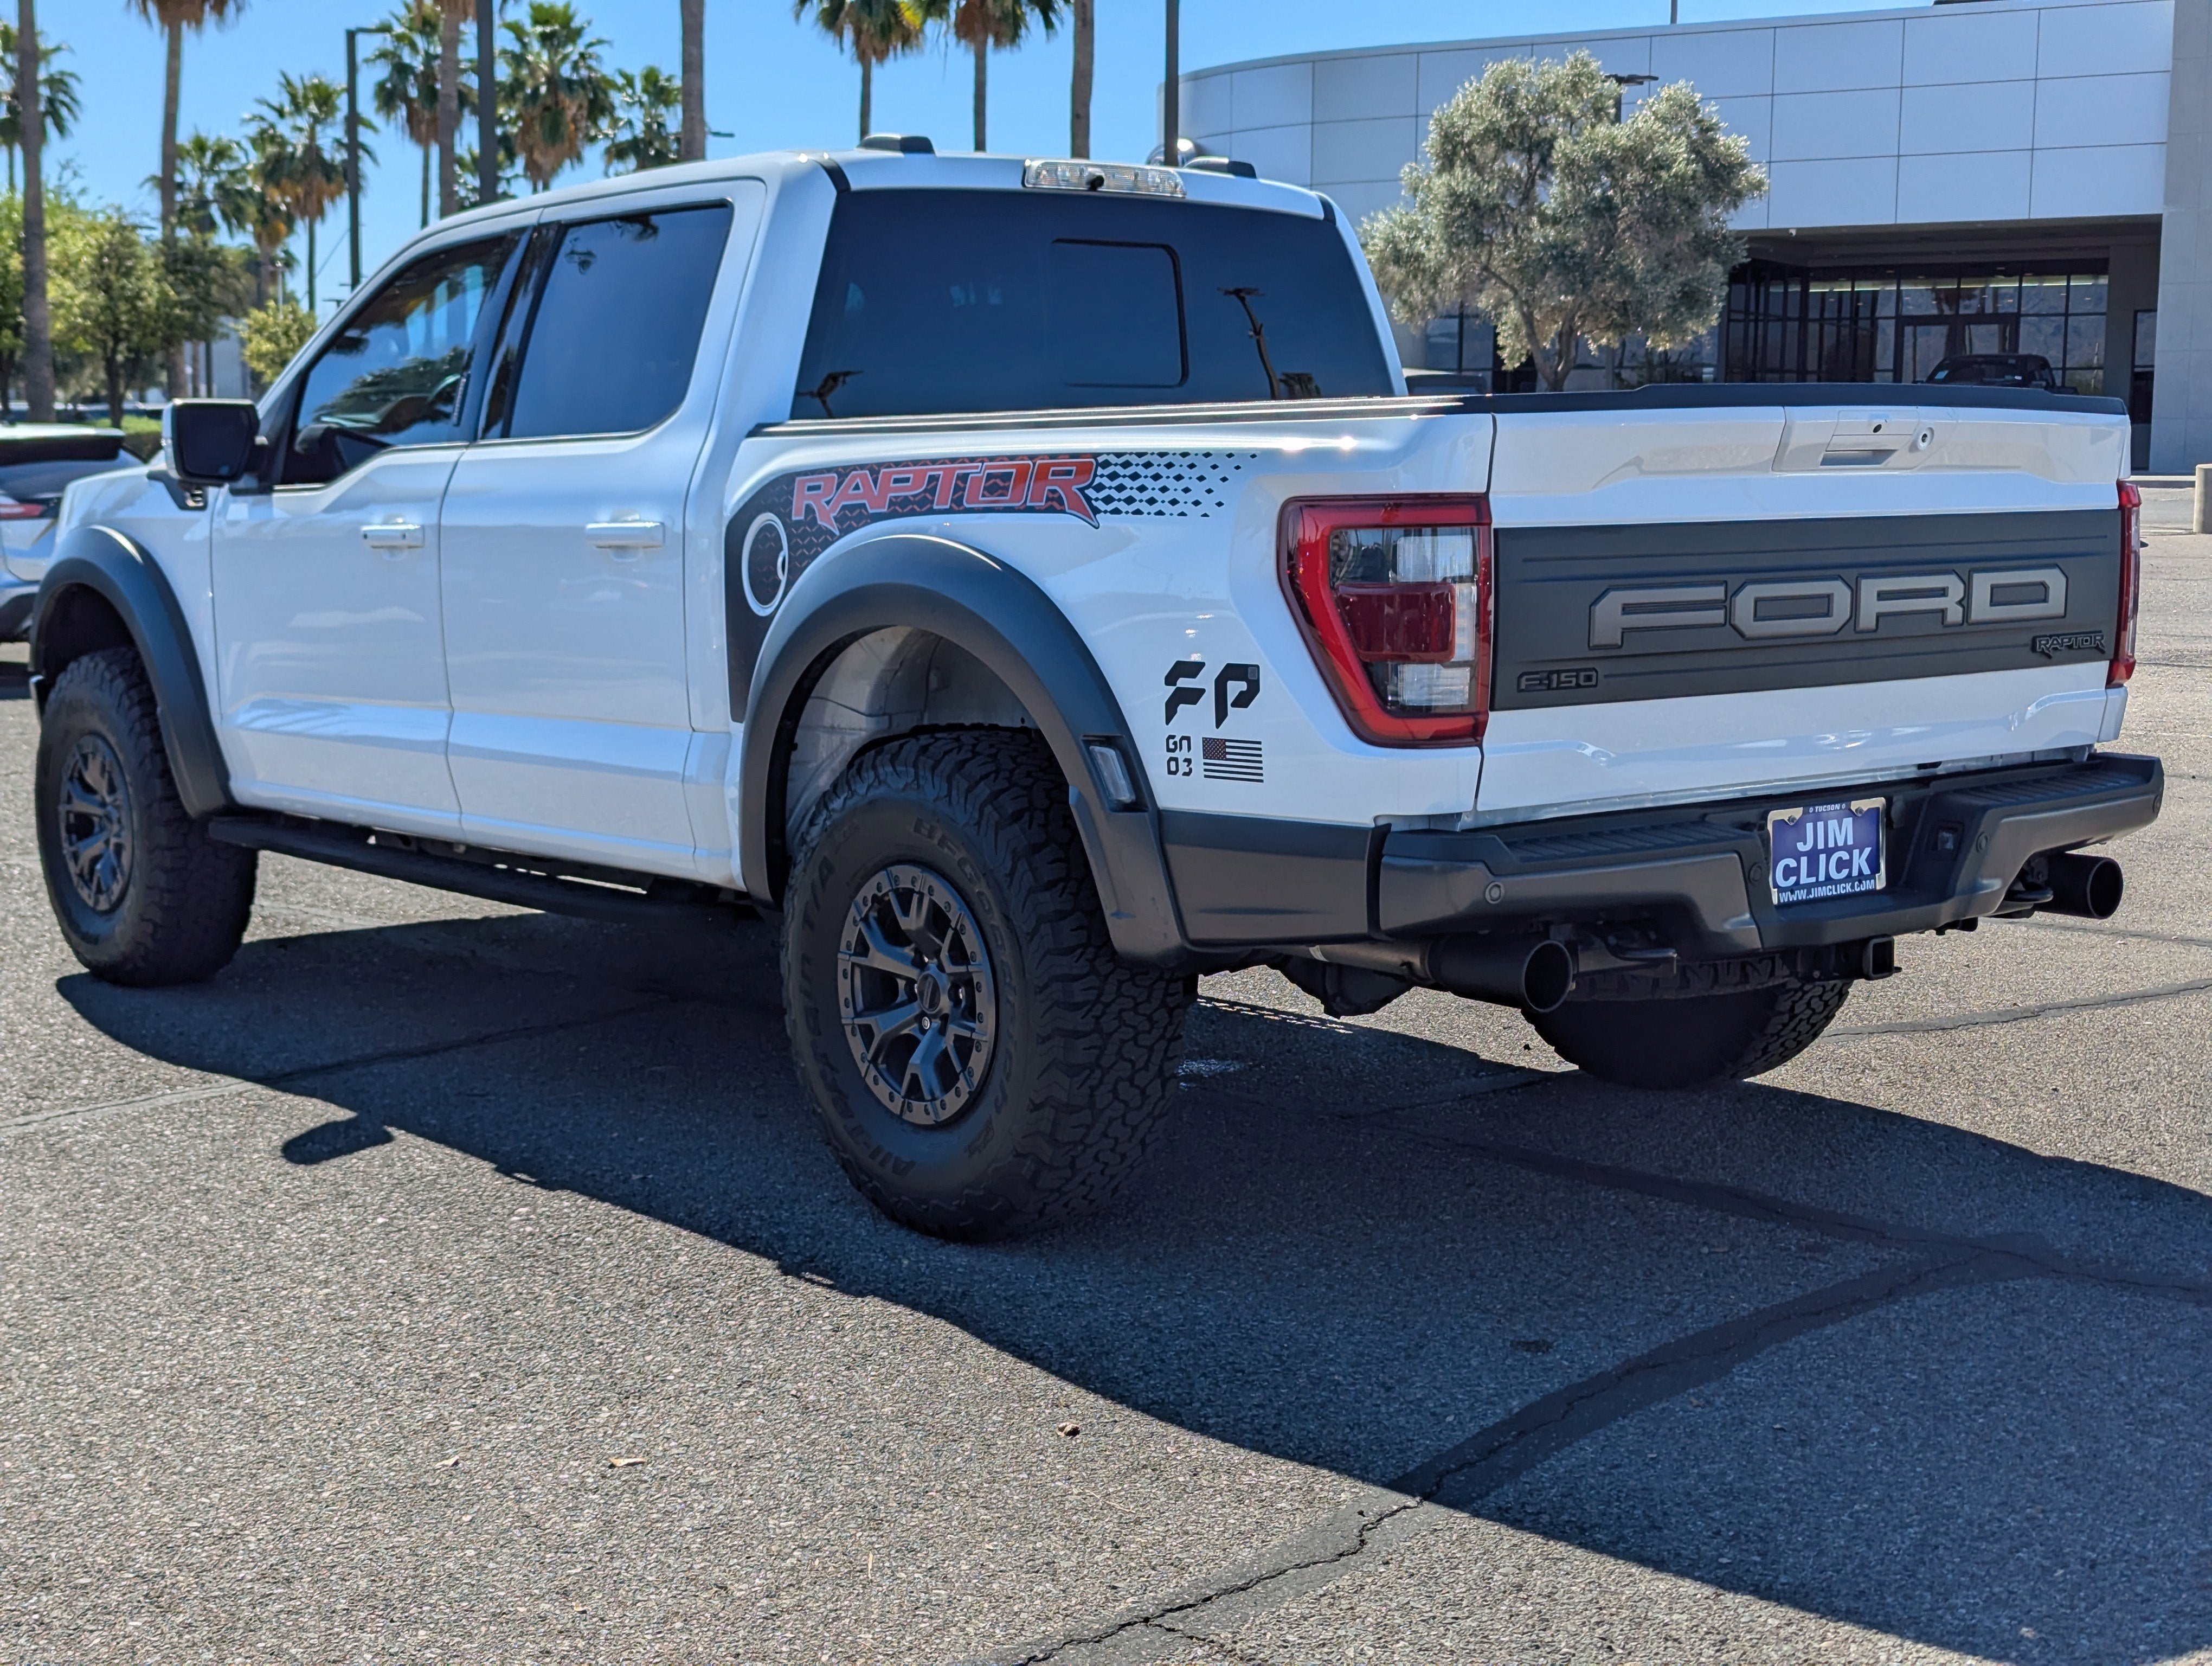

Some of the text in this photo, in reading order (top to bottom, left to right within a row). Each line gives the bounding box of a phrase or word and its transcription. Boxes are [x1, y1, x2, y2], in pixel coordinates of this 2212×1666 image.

[792, 458, 1099, 536] RAPTOR
[1588, 563, 2068, 650] FORD
[2035, 632, 2106, 658] RAPTOR
[1165, 660, 1261, 729] FP
[1518, 668, 1598, 691] F-150
[1815, 804, 1841, 813] TUCSON
[1797, 817, 1853, 851] JIM
[1776, 847, 1872, 887] CLICK
[1779, 879, 1875, 904] WWW.JIMCLICK.COM
